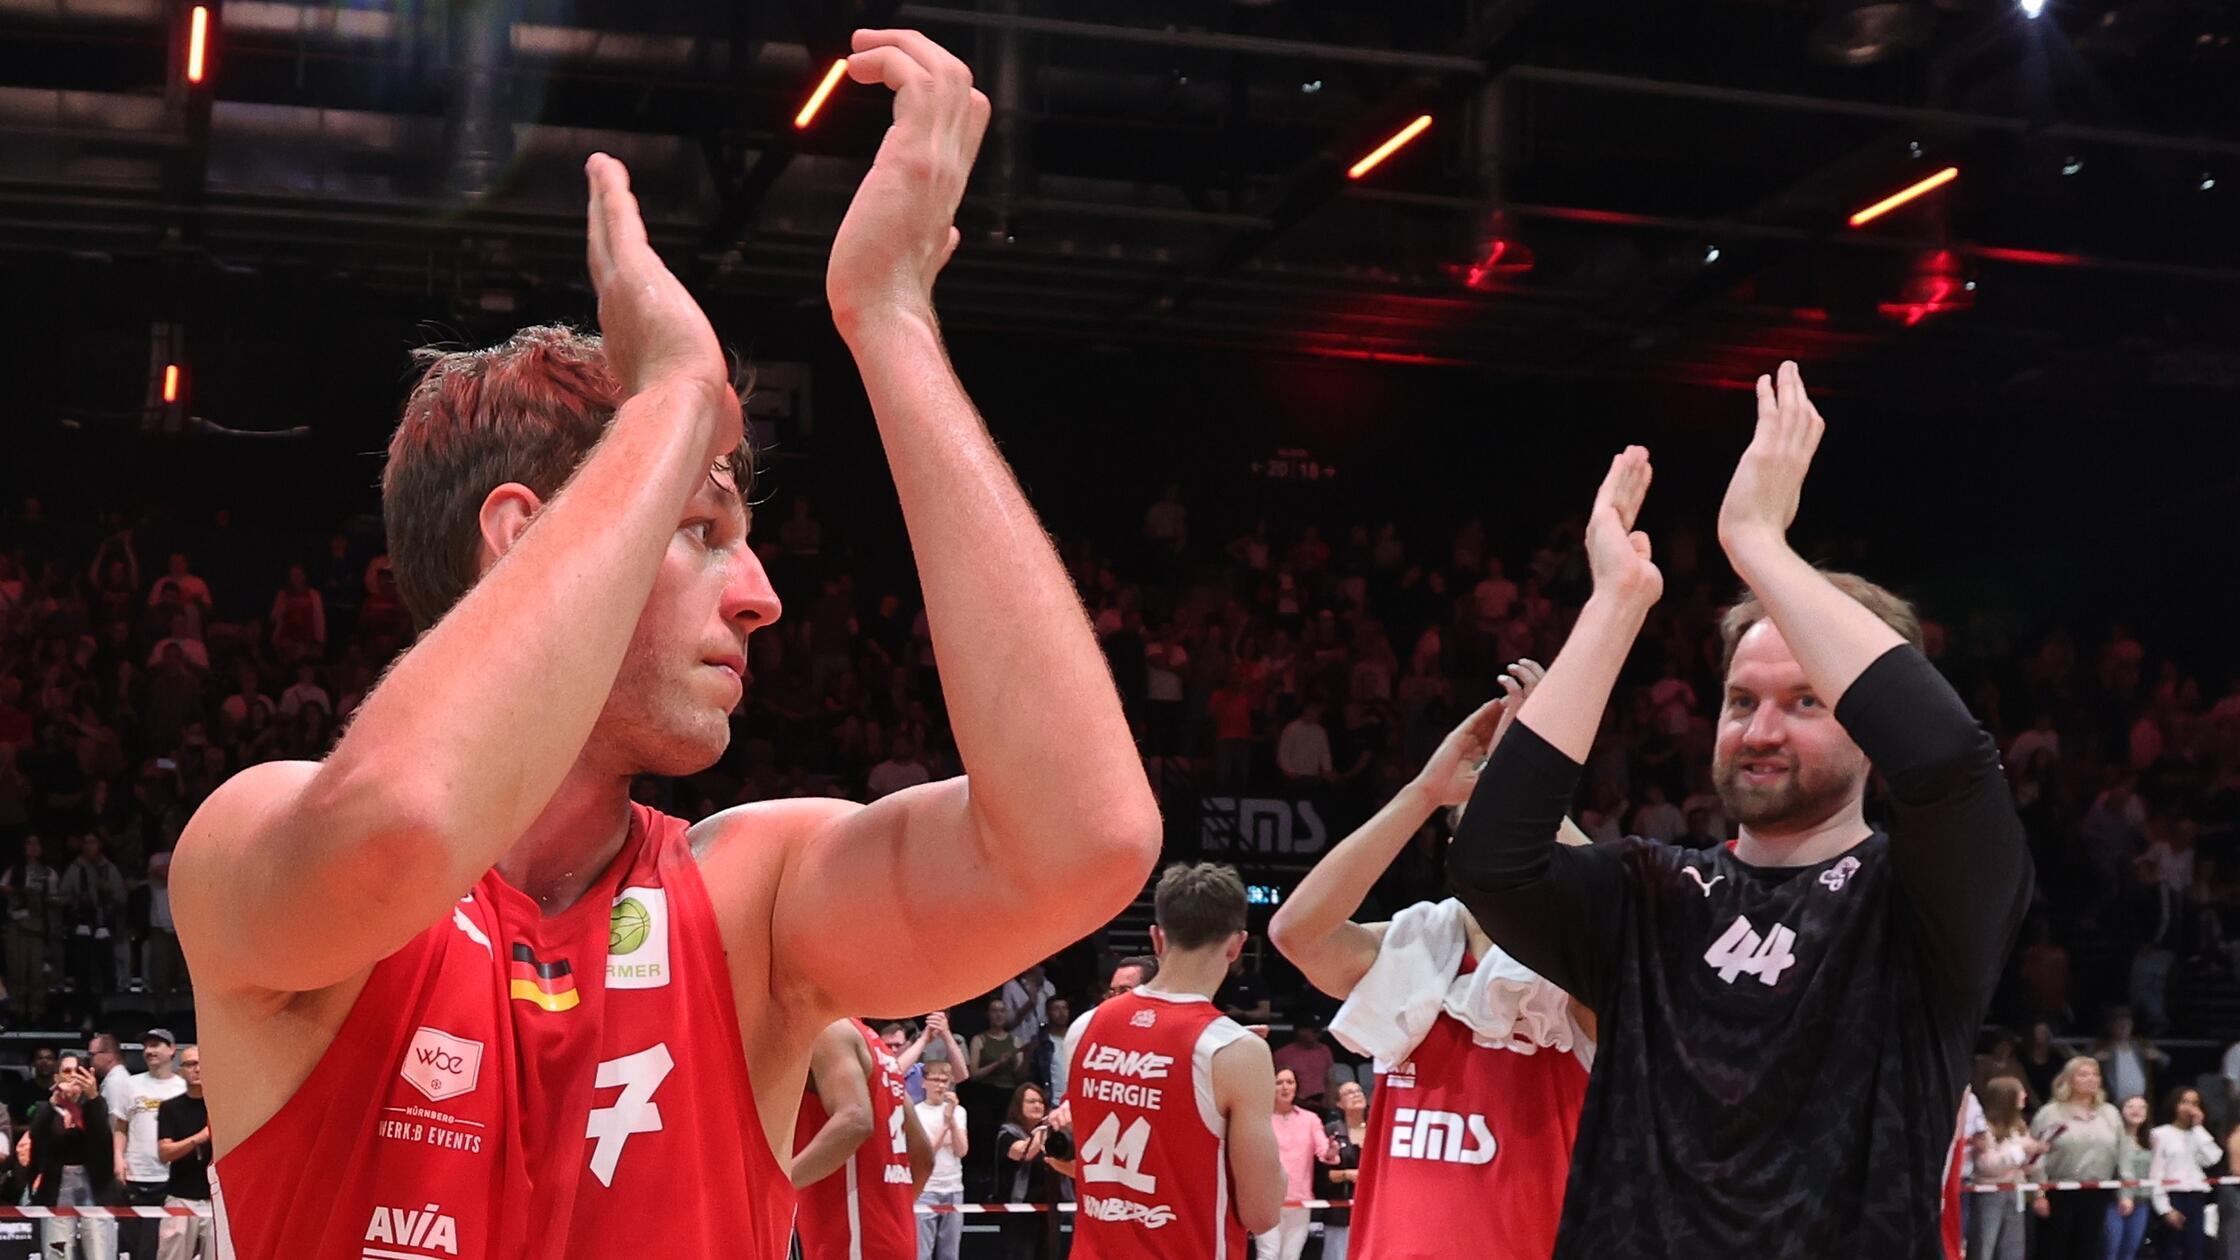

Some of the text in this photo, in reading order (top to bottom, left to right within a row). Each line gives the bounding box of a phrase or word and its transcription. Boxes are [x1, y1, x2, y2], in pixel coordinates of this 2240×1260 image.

[1703, 914, 1797, 986] 44
[1082, 1042, 1174, 1079] LENKE
[427, 1126, 482, 1154] EVENTS
[584, 1042, 676, 1188] 7
[1081, 1111, 1156, 1195] 11
